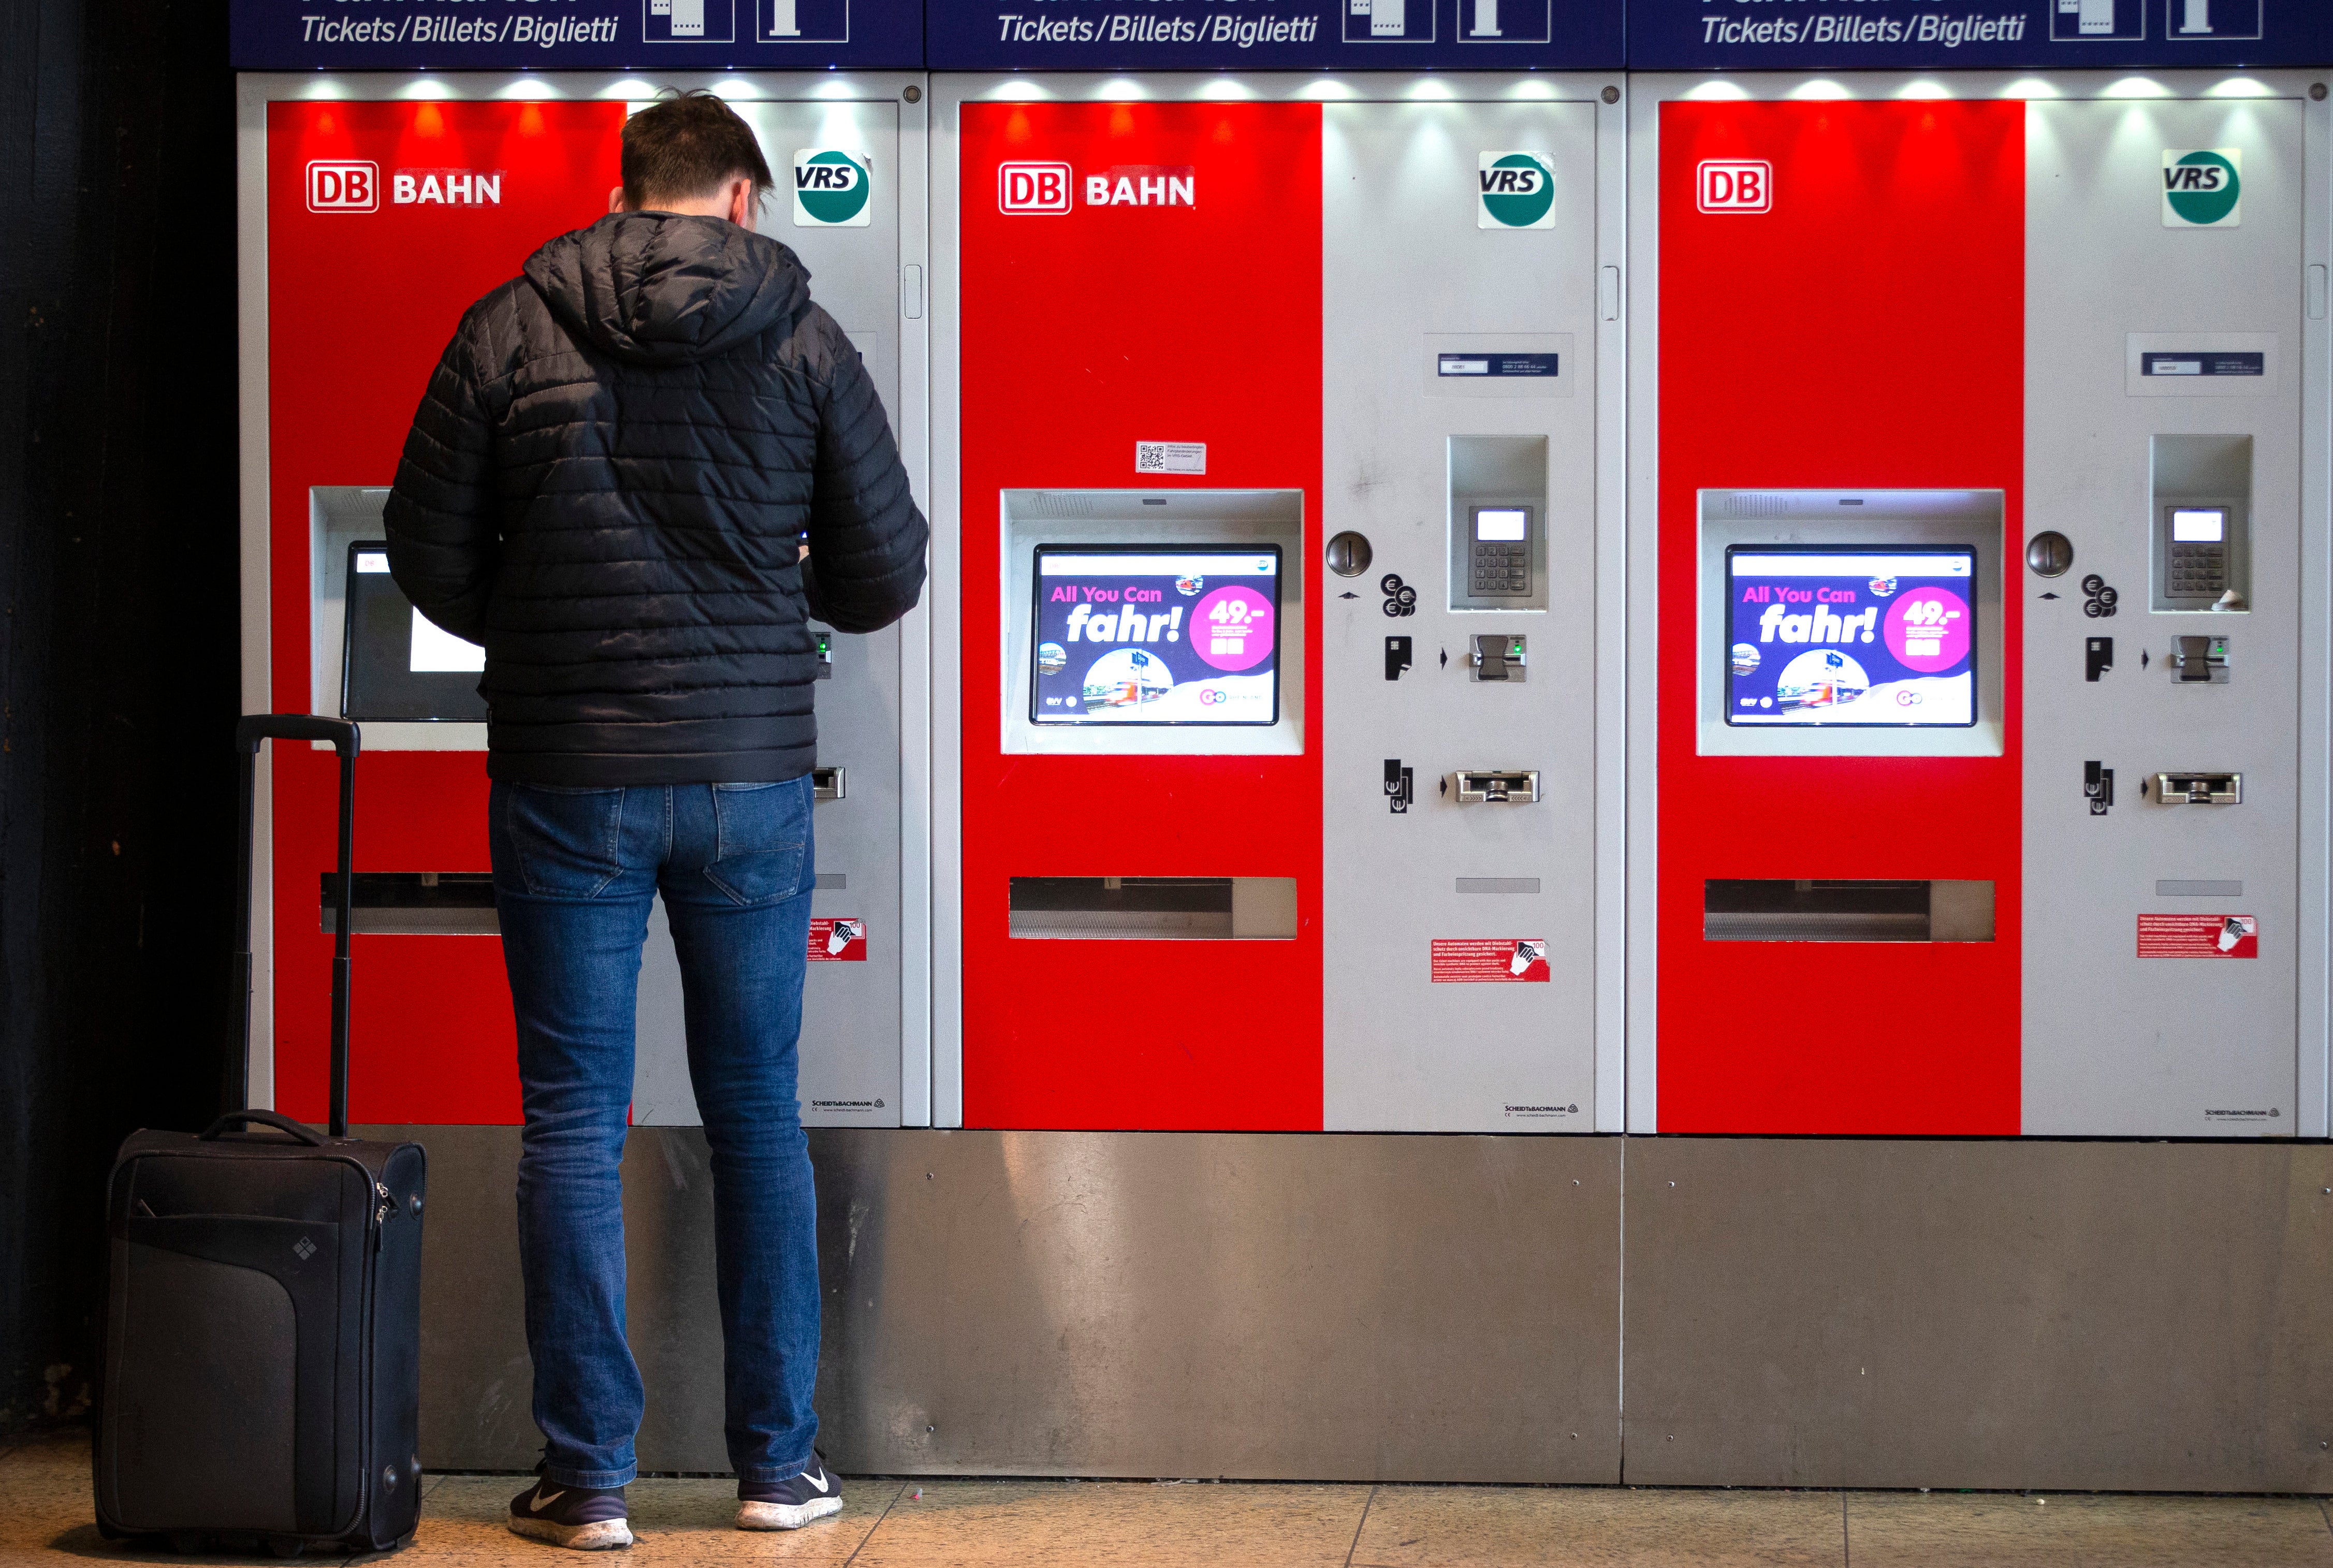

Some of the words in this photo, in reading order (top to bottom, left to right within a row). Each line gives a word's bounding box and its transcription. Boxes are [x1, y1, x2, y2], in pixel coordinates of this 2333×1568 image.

[393, 175, 500, 204] BAHN
[795, 167, 851, 189] VRS
[1480, 170, 1536, 192] VRS
[2165, 167, 2220, 190] VRS
[1086, 177, 1194, 206] BAHN
[1051, 585, 1077, 603] All
[1082, 587, 1119, 603] You
[1124, 587, 1162, 603] Can
[1742, 586, 1770, 603] All
[1774, 587, 1812, 603] You
[1816, 587, 1856, 603] Can
[1067, 604, 1183, 643] fahr!
[1759, 604, 1878, 643] fahr!
